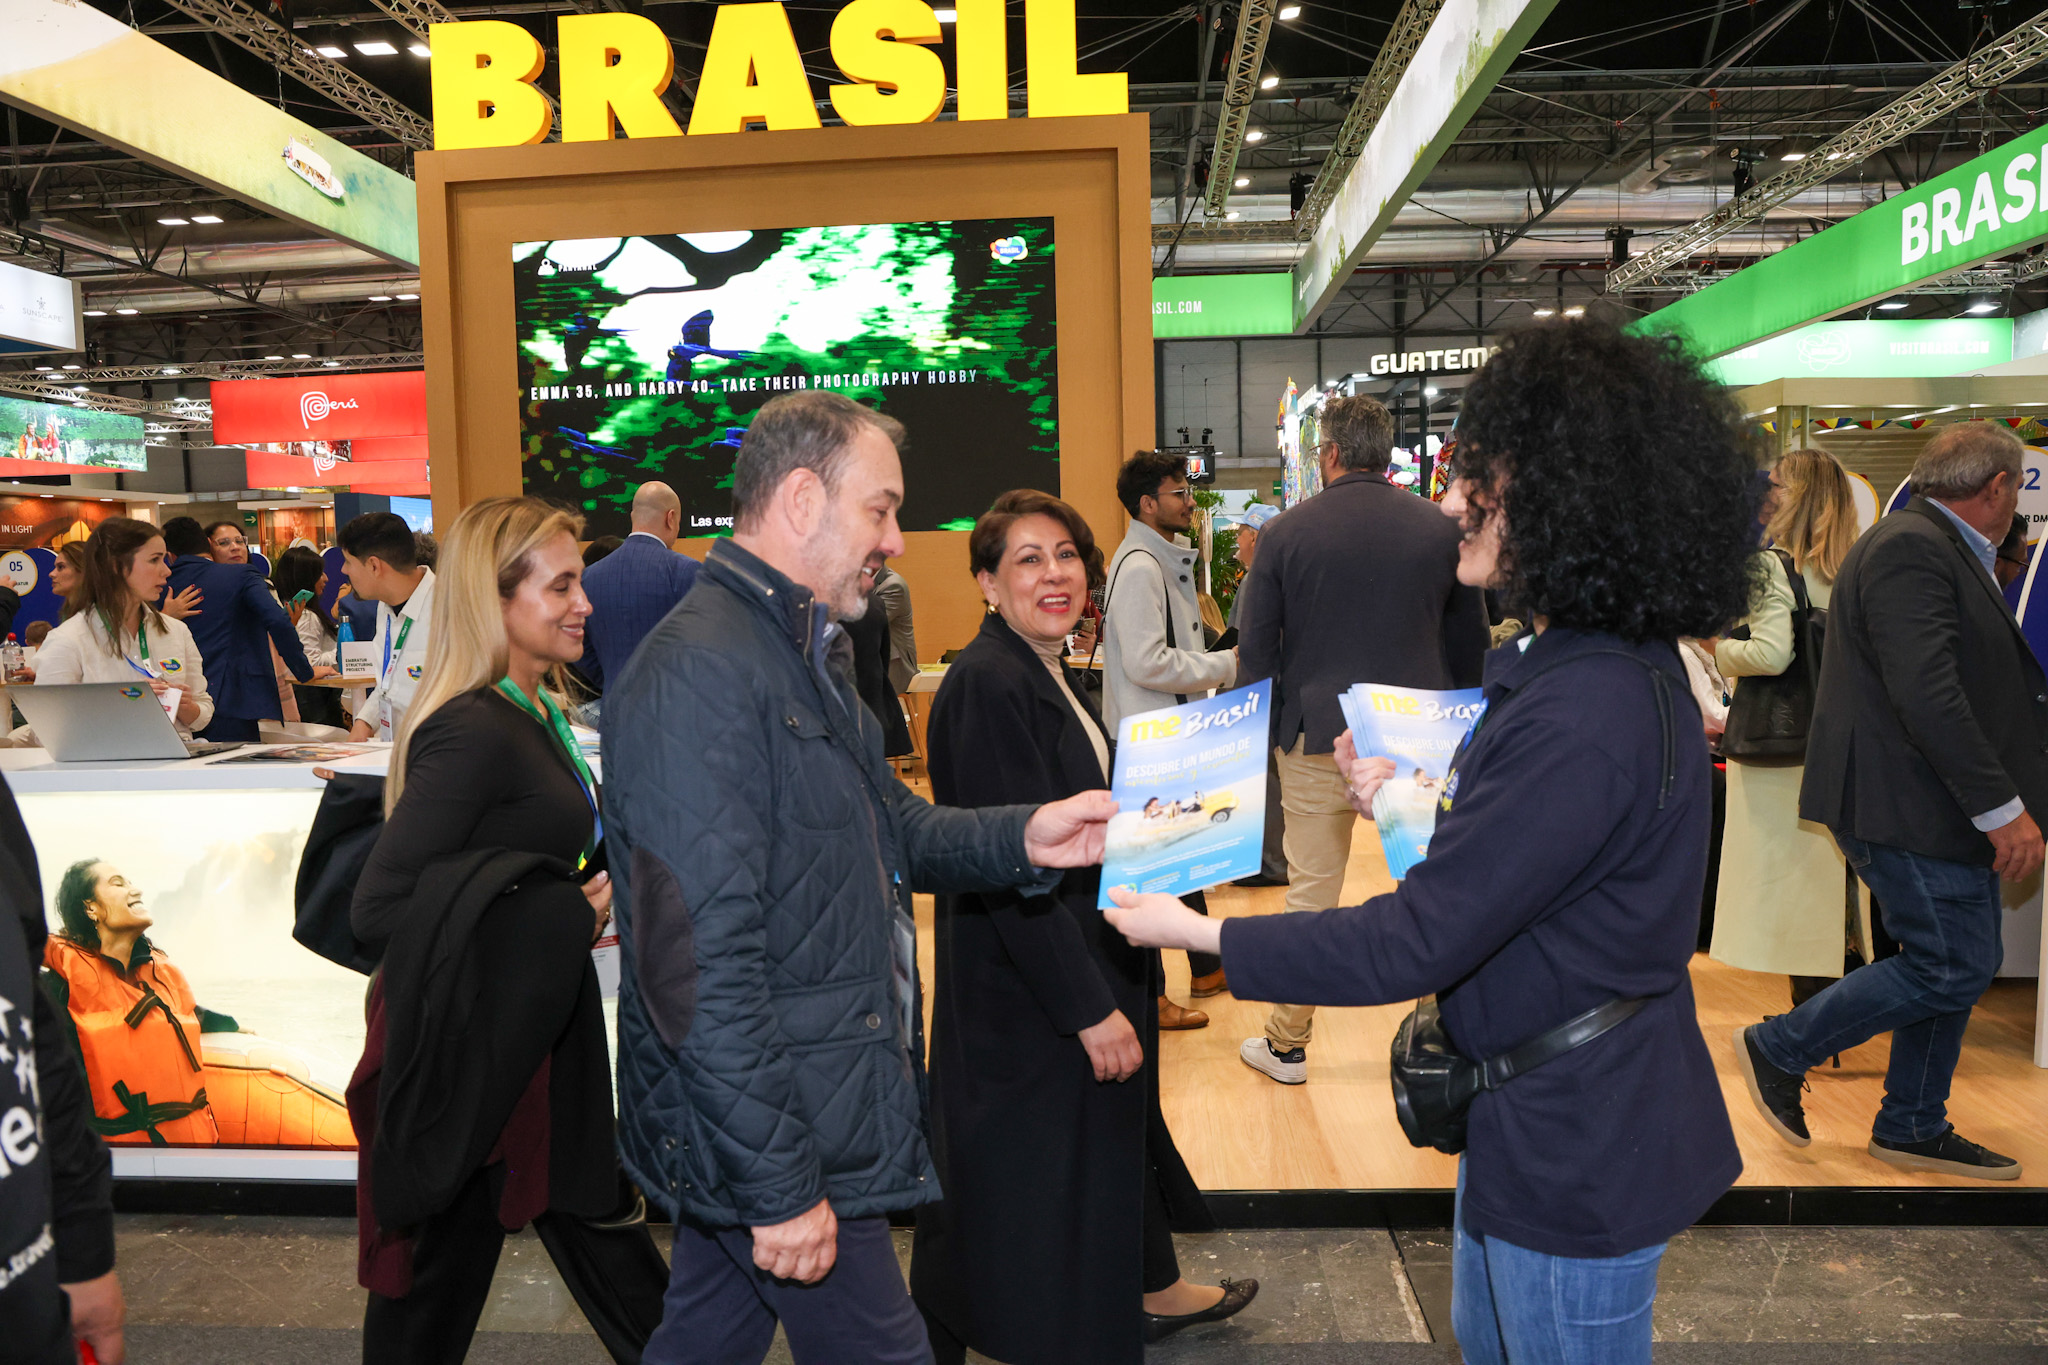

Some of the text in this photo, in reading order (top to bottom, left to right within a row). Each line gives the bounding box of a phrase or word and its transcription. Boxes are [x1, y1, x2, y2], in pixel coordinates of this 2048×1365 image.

[429, 0, 1129, 150] BRASIL
[531, 384, 570, 401] EMMA
[576, 384, 599, 399] 35,
[605, 382, 632, 397] AND
[639, 380, 684, 396] HARRY
[691, 379, 714, 395] 40,
[721, 377, 757, 392] TAKE
[764, 375, 807, 391] THEIR
[814, 371, 920, 389] PHOTOGRAPHY
[928, 369, 977, 384] HOBBY
[301, 391, 359, 430] Perú
[1, 524, 33, 534] IN LIGHT
[690, 515, 712, 527] Las
[9, 561, 23, 572] 05
[1184, 691, 1260, 739] Brasil
[1126, 758, 1181, 778] DESCUBRE
[1183, 754, 1197, 769] UN
[1199, 741, 1236, 763] MUNDO
[1237, 736, 1251, 752] DE
[1382, 735, 1435, 751] DESCUBRE
[1436, 738, 1452, 751] UN
